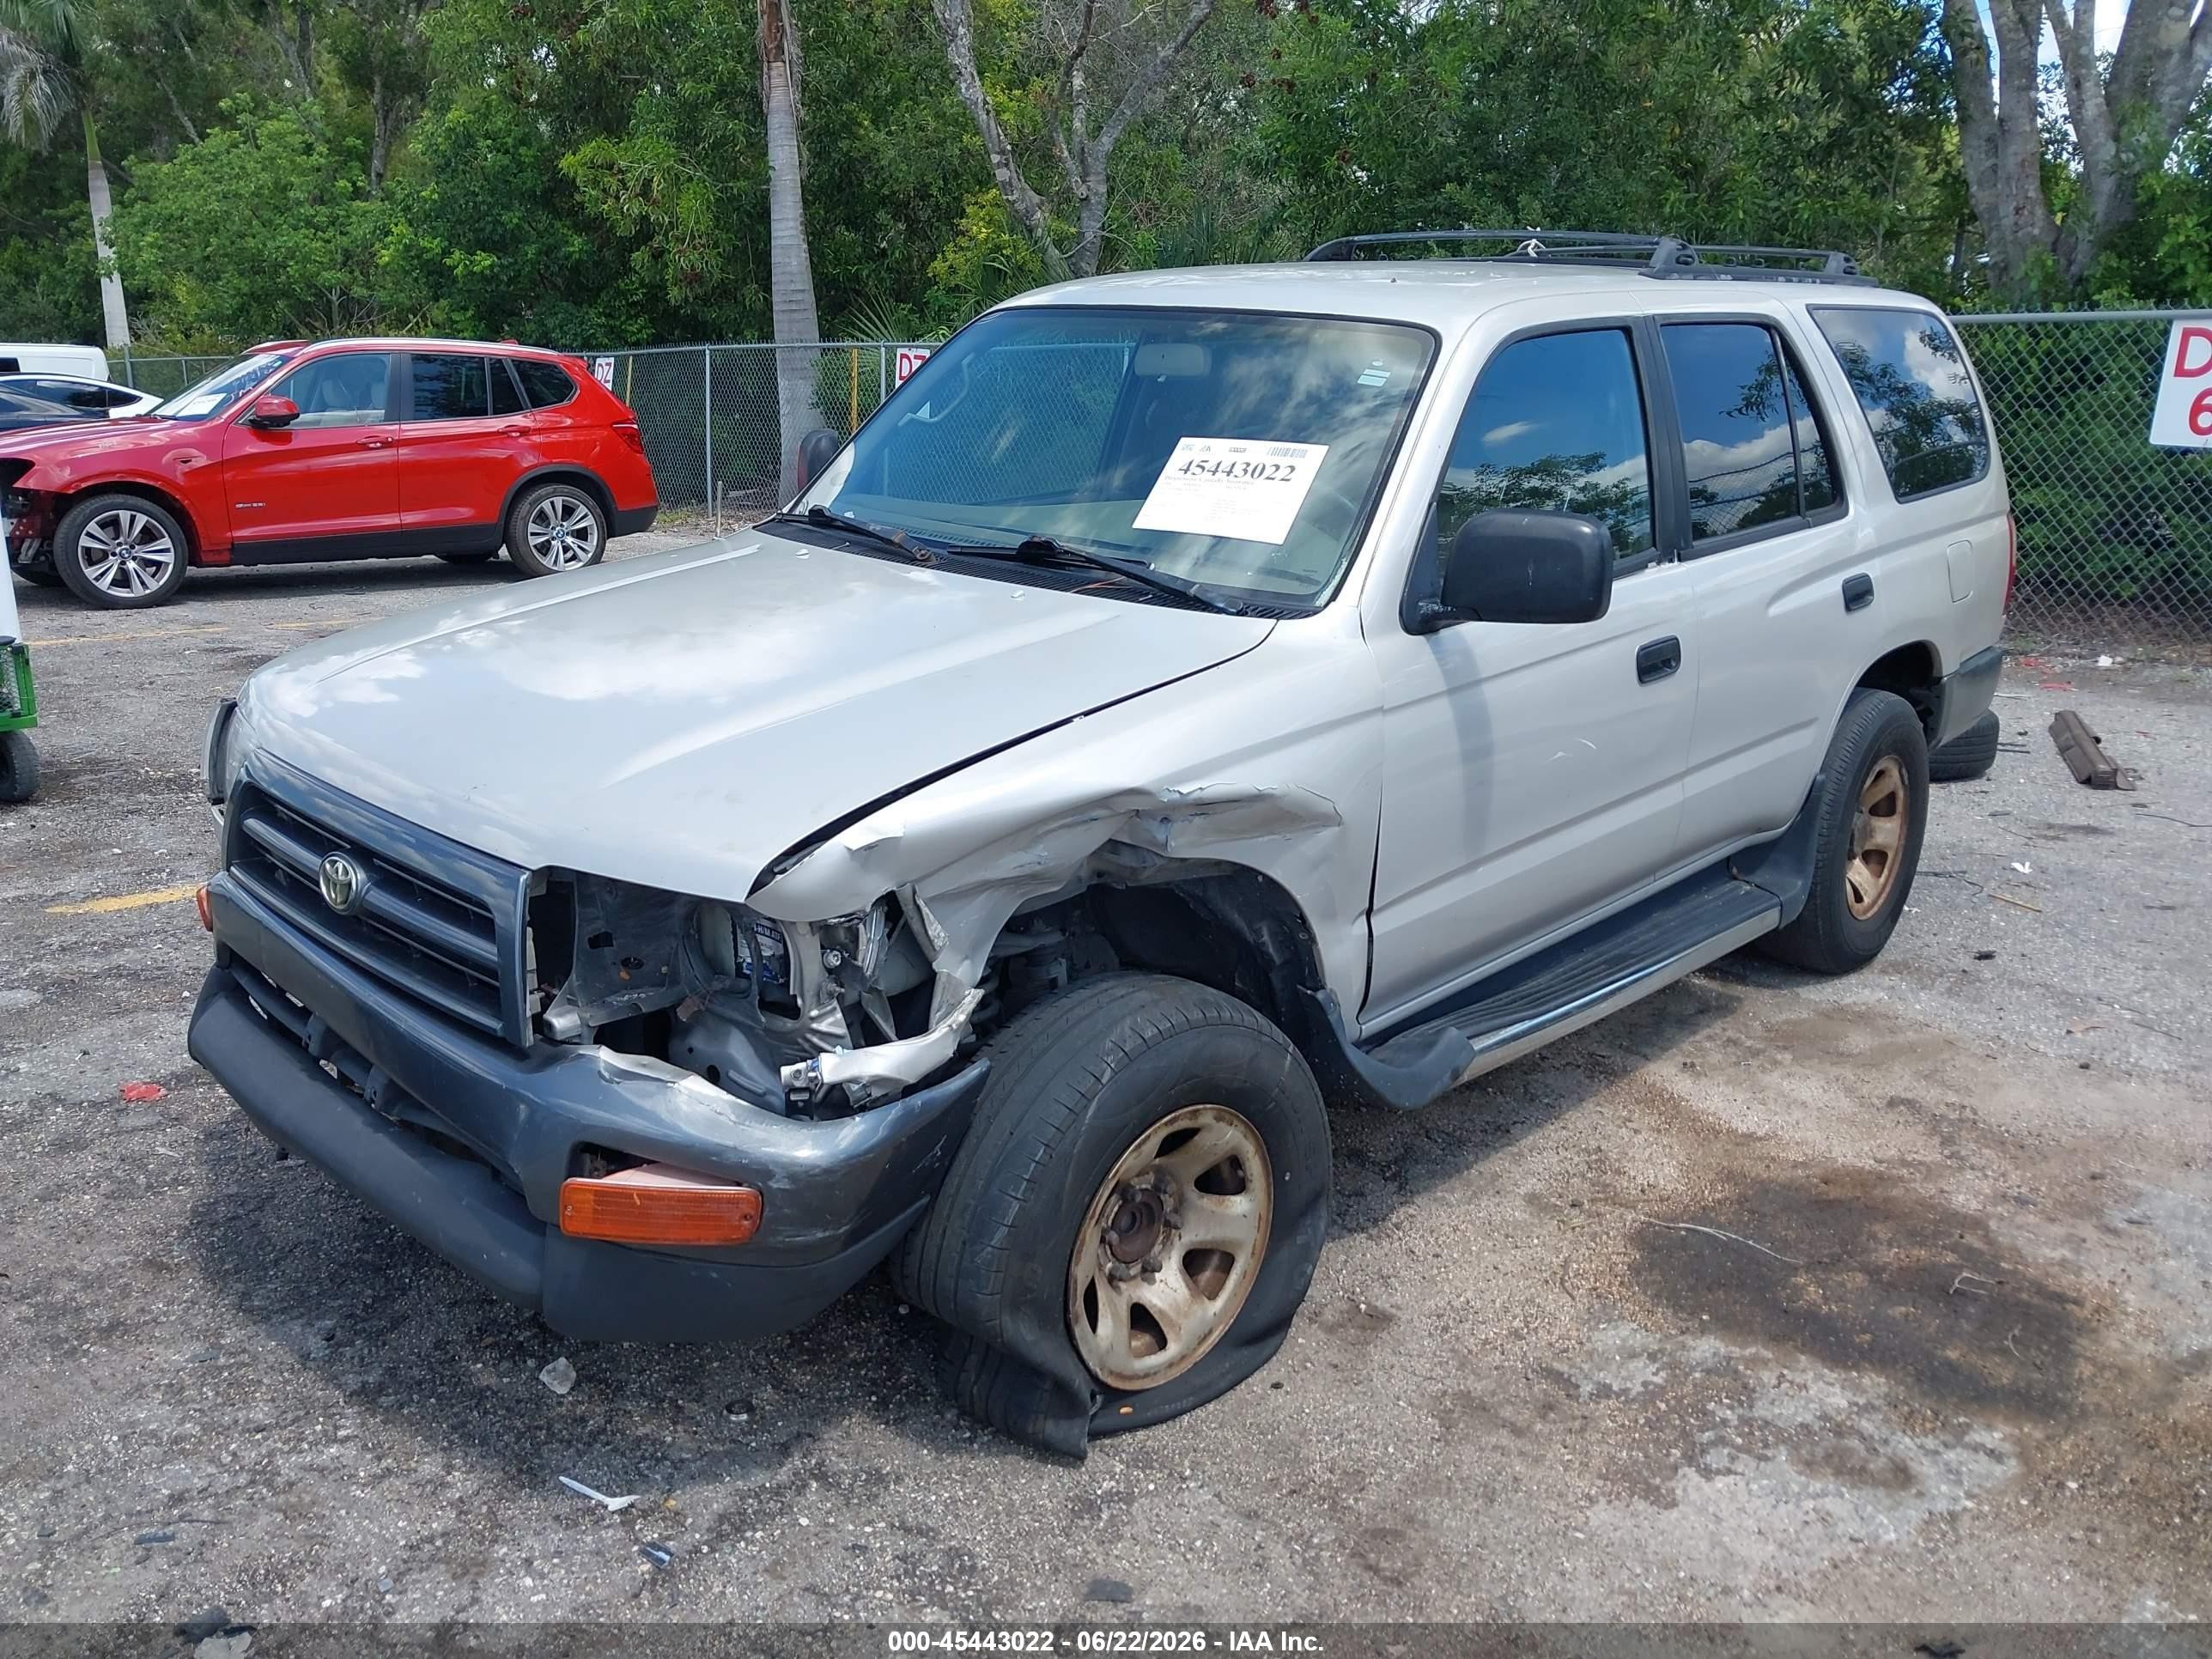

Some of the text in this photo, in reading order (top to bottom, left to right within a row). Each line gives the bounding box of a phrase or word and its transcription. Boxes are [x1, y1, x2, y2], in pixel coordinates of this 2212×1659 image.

[597, 362, 612, 383] DZ
[2190, 387, 2212, 436] 6
[1178, 459, 1297, 482] 45443022
